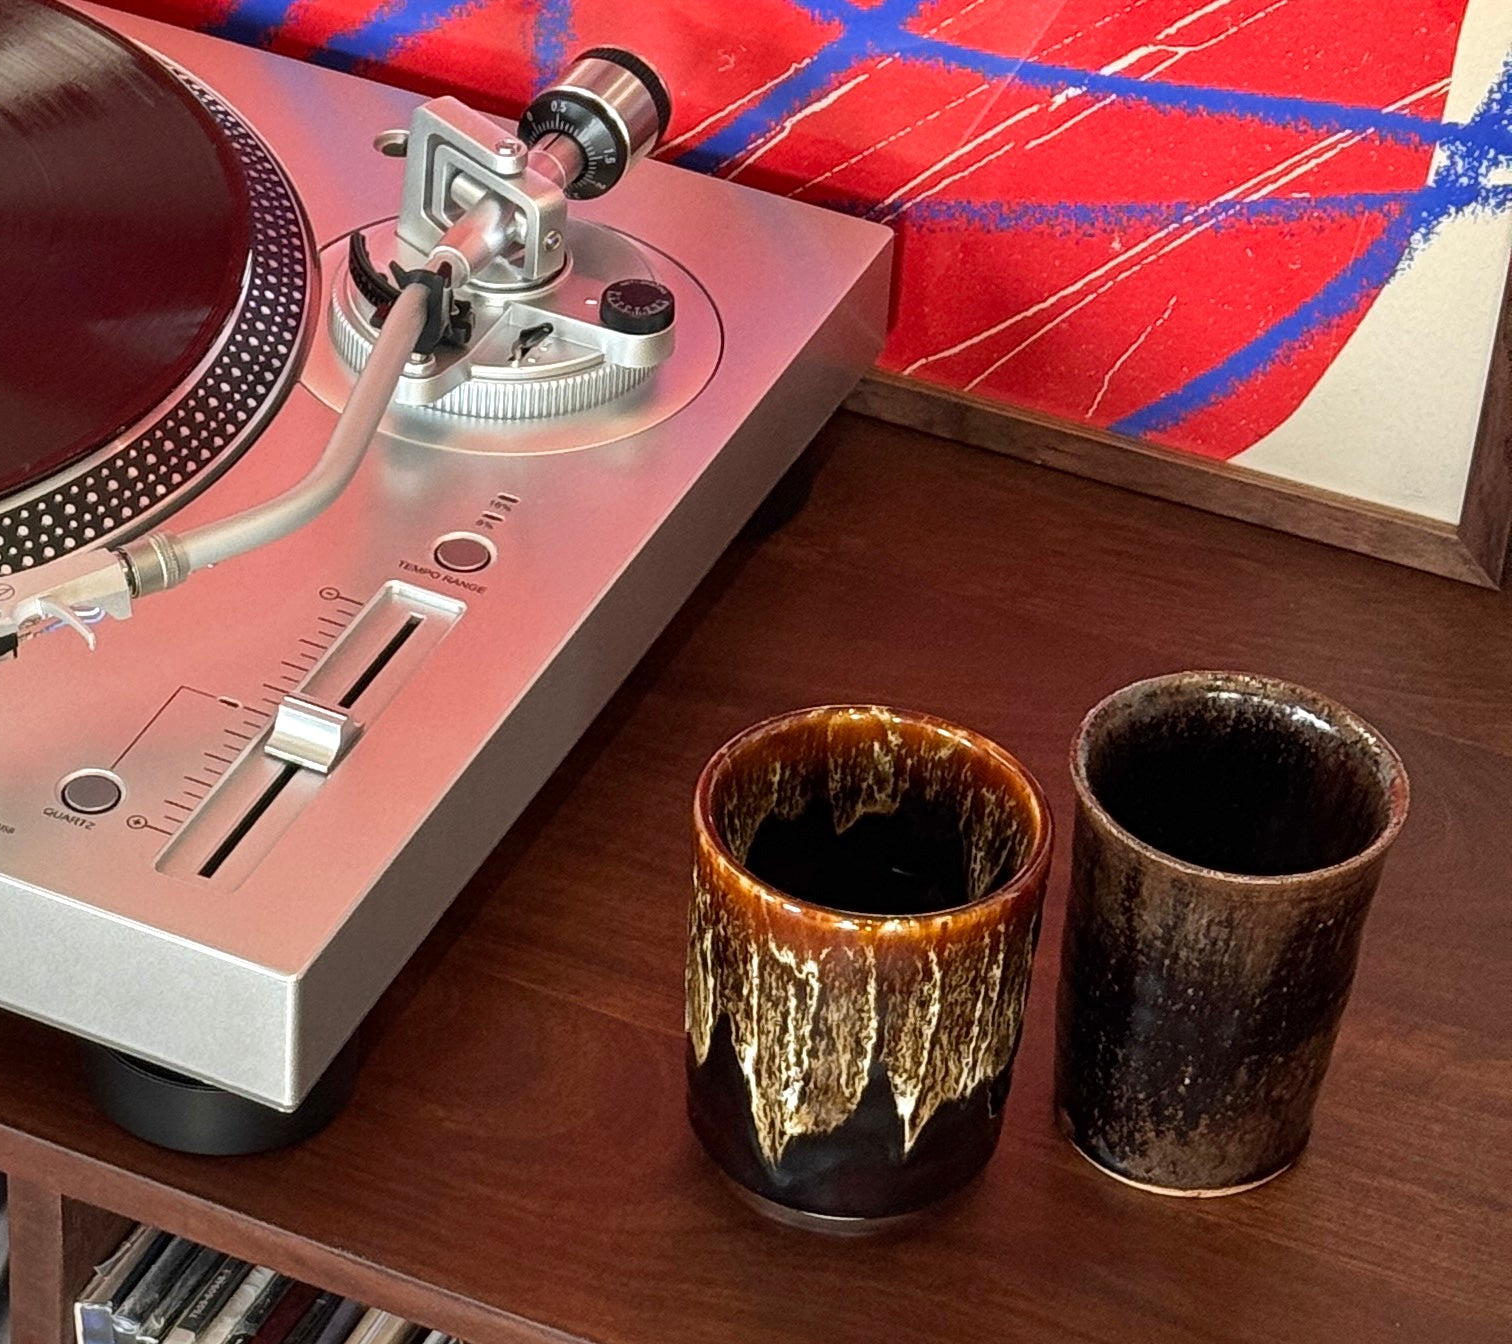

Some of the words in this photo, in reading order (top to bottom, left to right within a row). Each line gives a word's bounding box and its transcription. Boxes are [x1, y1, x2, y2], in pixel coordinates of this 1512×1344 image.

[398, 559, 440, 581] TEMPO
[441, 571, 486, 594] RANGE
[43, 806, 96, 831] QUARTZ
